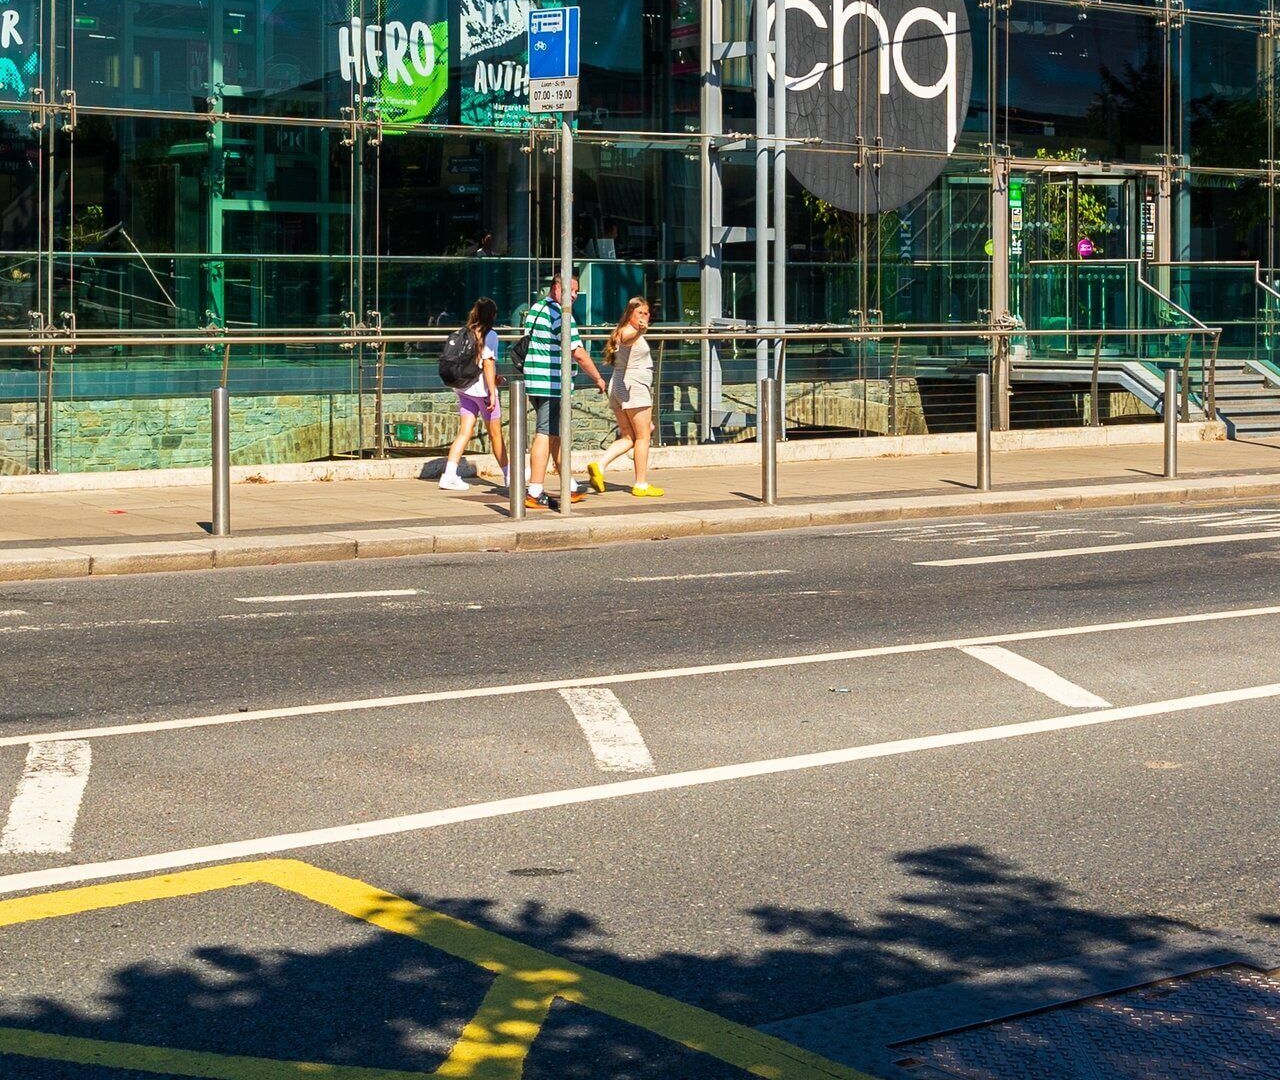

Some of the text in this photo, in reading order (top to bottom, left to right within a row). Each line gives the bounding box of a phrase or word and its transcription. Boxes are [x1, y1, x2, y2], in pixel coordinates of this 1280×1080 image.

[338, 16, 435, 86] HERO
[474, 60, 529, 97] AUTH
[354, 93, 383, 103] Bendan
[533, 91, 551, 100] 07.00
[556, 89, 572, 99] 19.00
